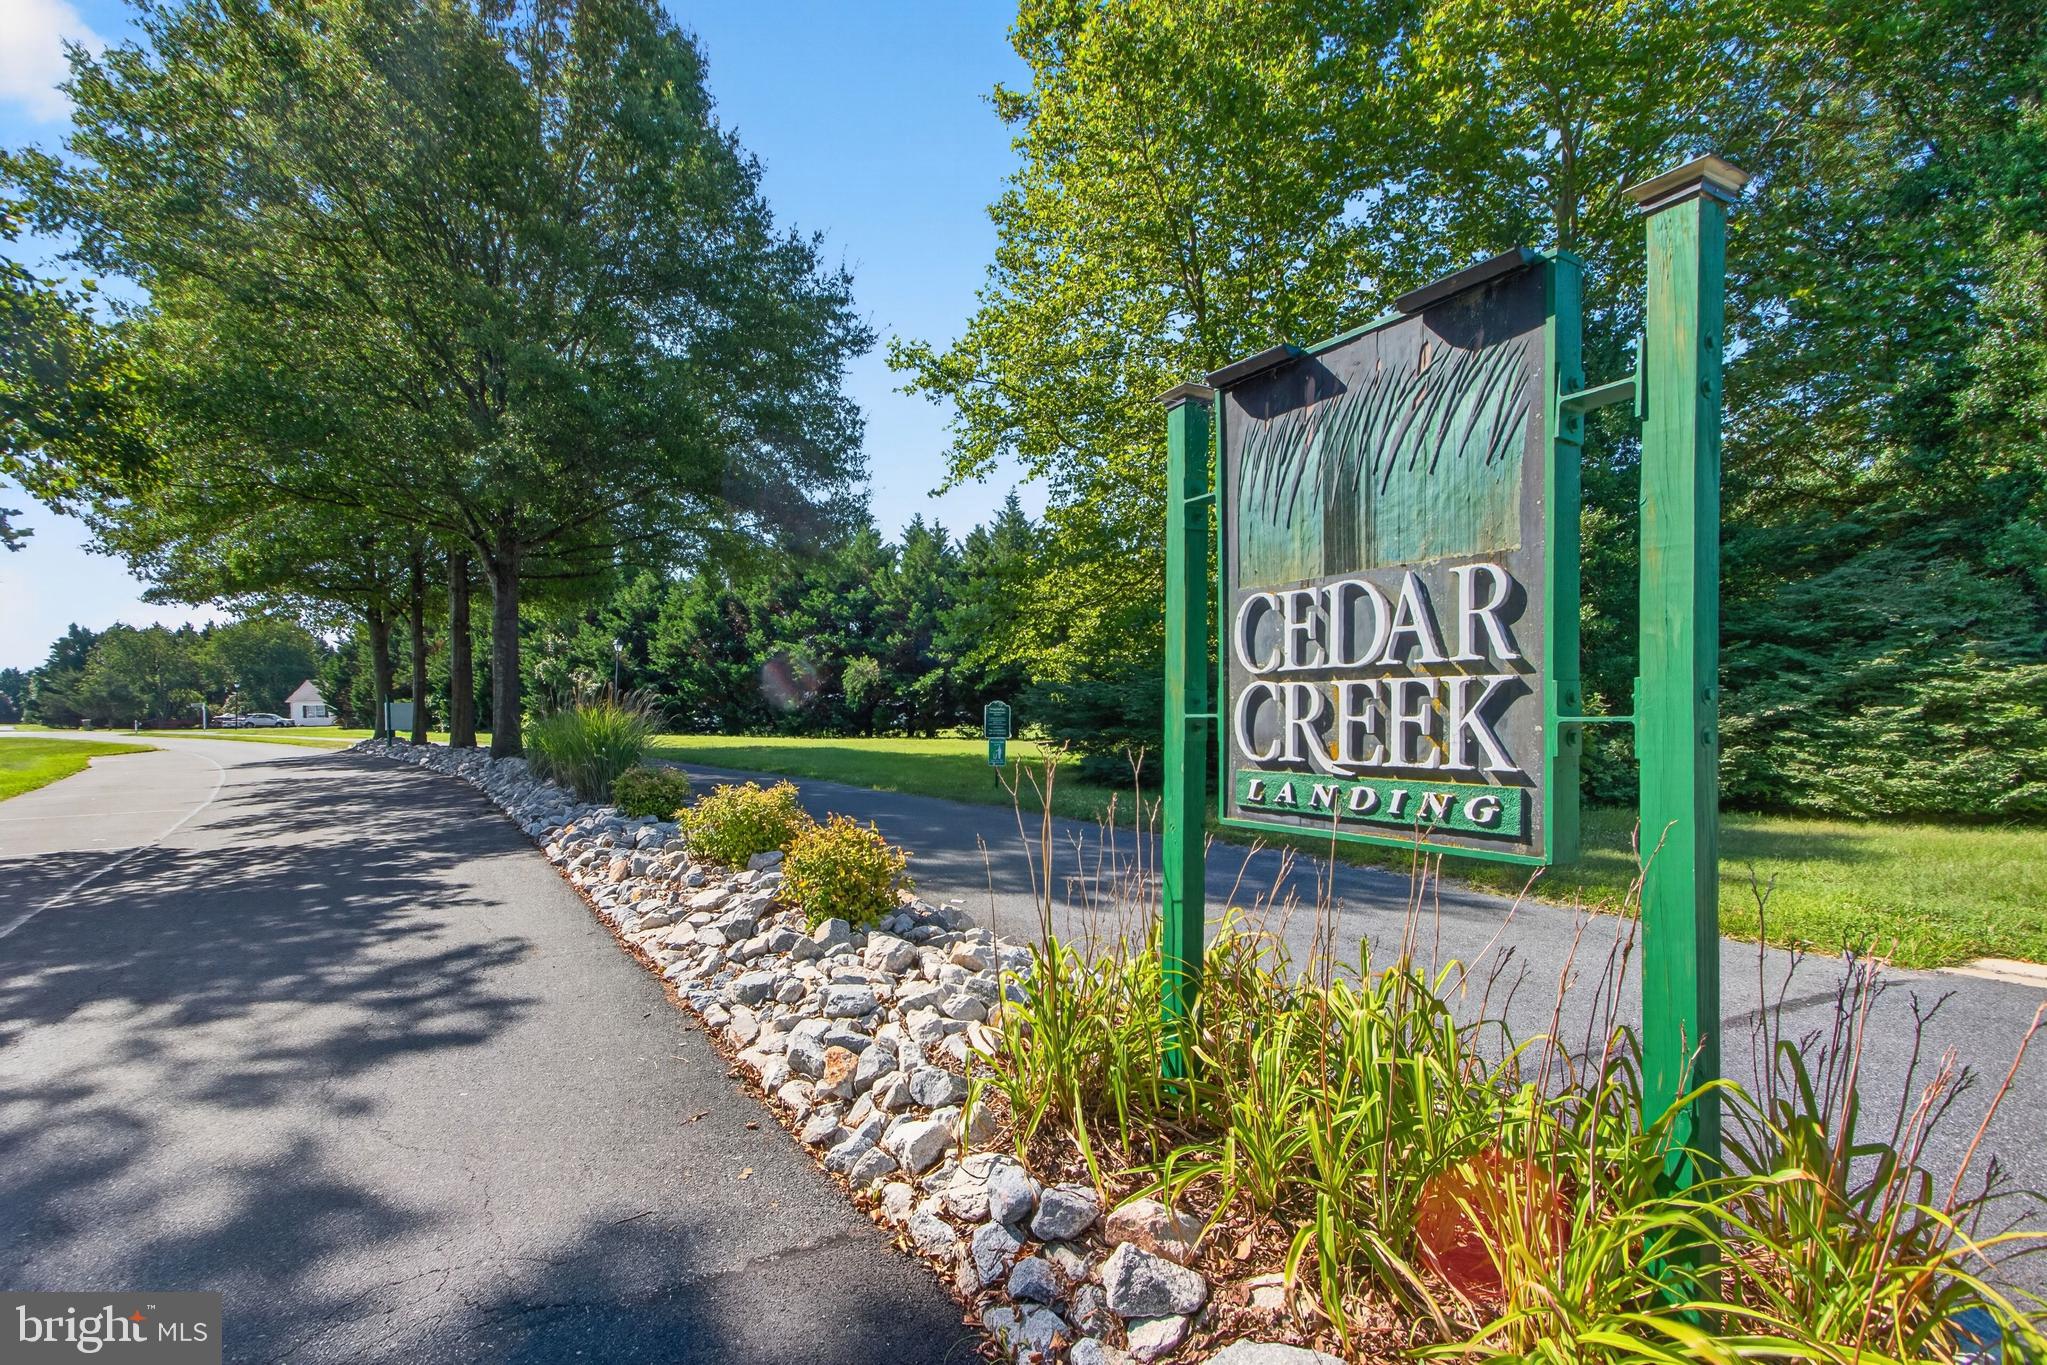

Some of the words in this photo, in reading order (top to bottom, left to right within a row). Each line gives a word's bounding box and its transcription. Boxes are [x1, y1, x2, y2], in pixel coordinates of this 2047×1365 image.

[1234, 562, 1521, 675] CEDAR
[1234, 674, 1521, 777] CREEK
[1246, 779, 1500, 823] LANDING
